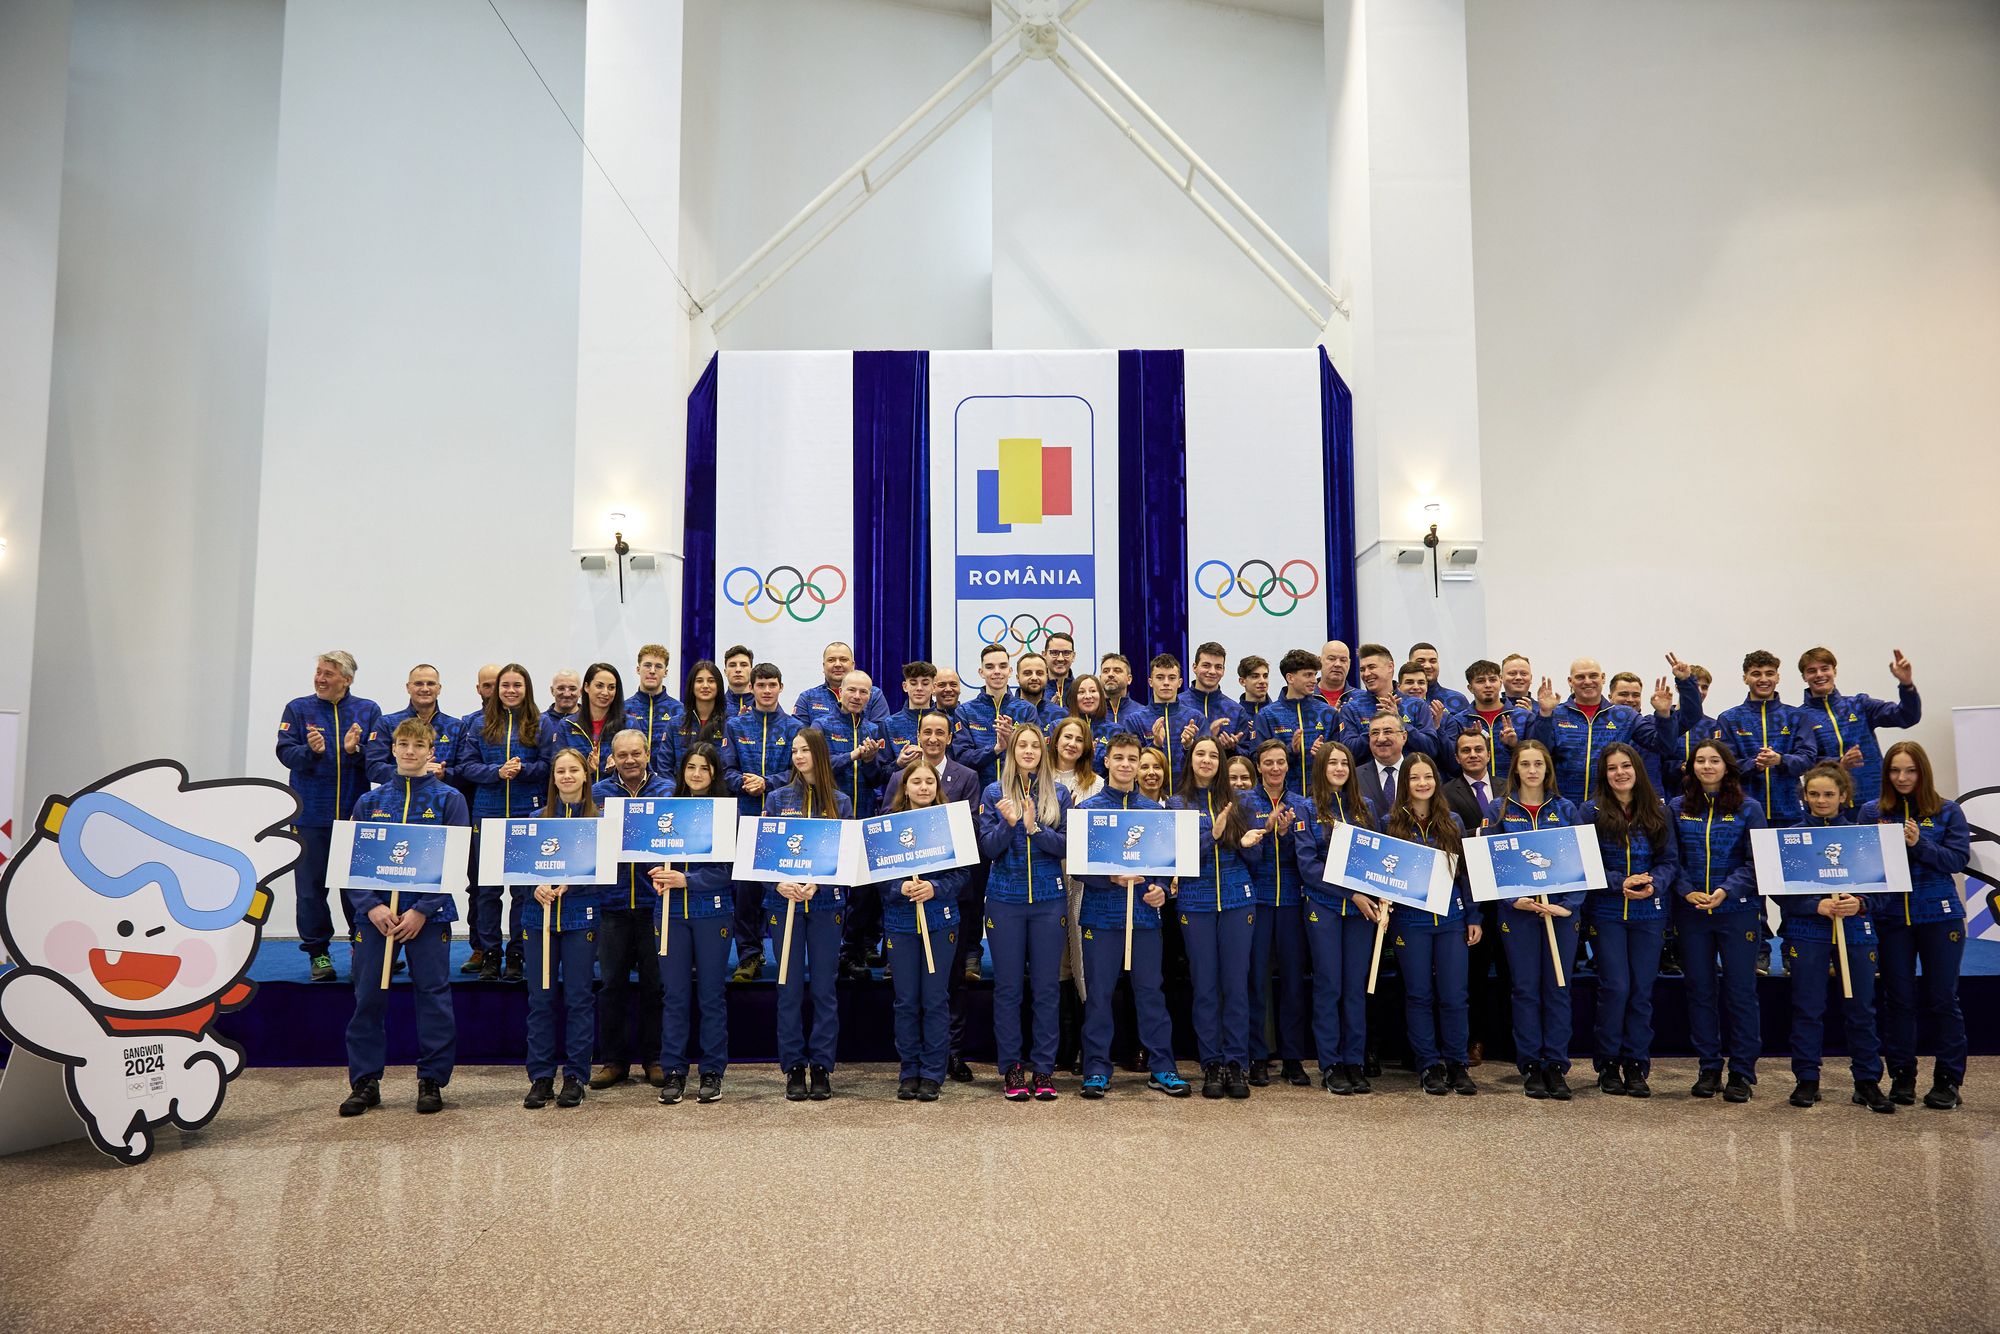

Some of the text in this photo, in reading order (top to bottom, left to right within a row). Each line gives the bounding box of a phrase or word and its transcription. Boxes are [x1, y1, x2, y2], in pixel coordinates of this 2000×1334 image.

[969, 566, 1082, 586] ROMÂNIA
[511, 828, 526, 836] 2024
[868, 826, 882, 834] 2024
[651, 839, 684, 848] SCHI FOND
[1356, 837, 1370, 846] 2024
[905, 852, 915, 861] CU
[915, 845, 947, 860] SCHIURILE
[1123, 851, 1141, 860] SANIE
[535, 860, 566, 870] SKELETON
[779, 858, 813, 869] SCHI ALPIN
[376, 865, 417, 877] SNOWBOARD
[1532, 870, 1547, 880] BOB
[1818, 868, 1849, 878] BIATLON
[1365, 870, 1389, 885] PATINAJ
[123, 1043, 164, 1060] GANGWON
[125, 1055, 165, 1077] 2024
